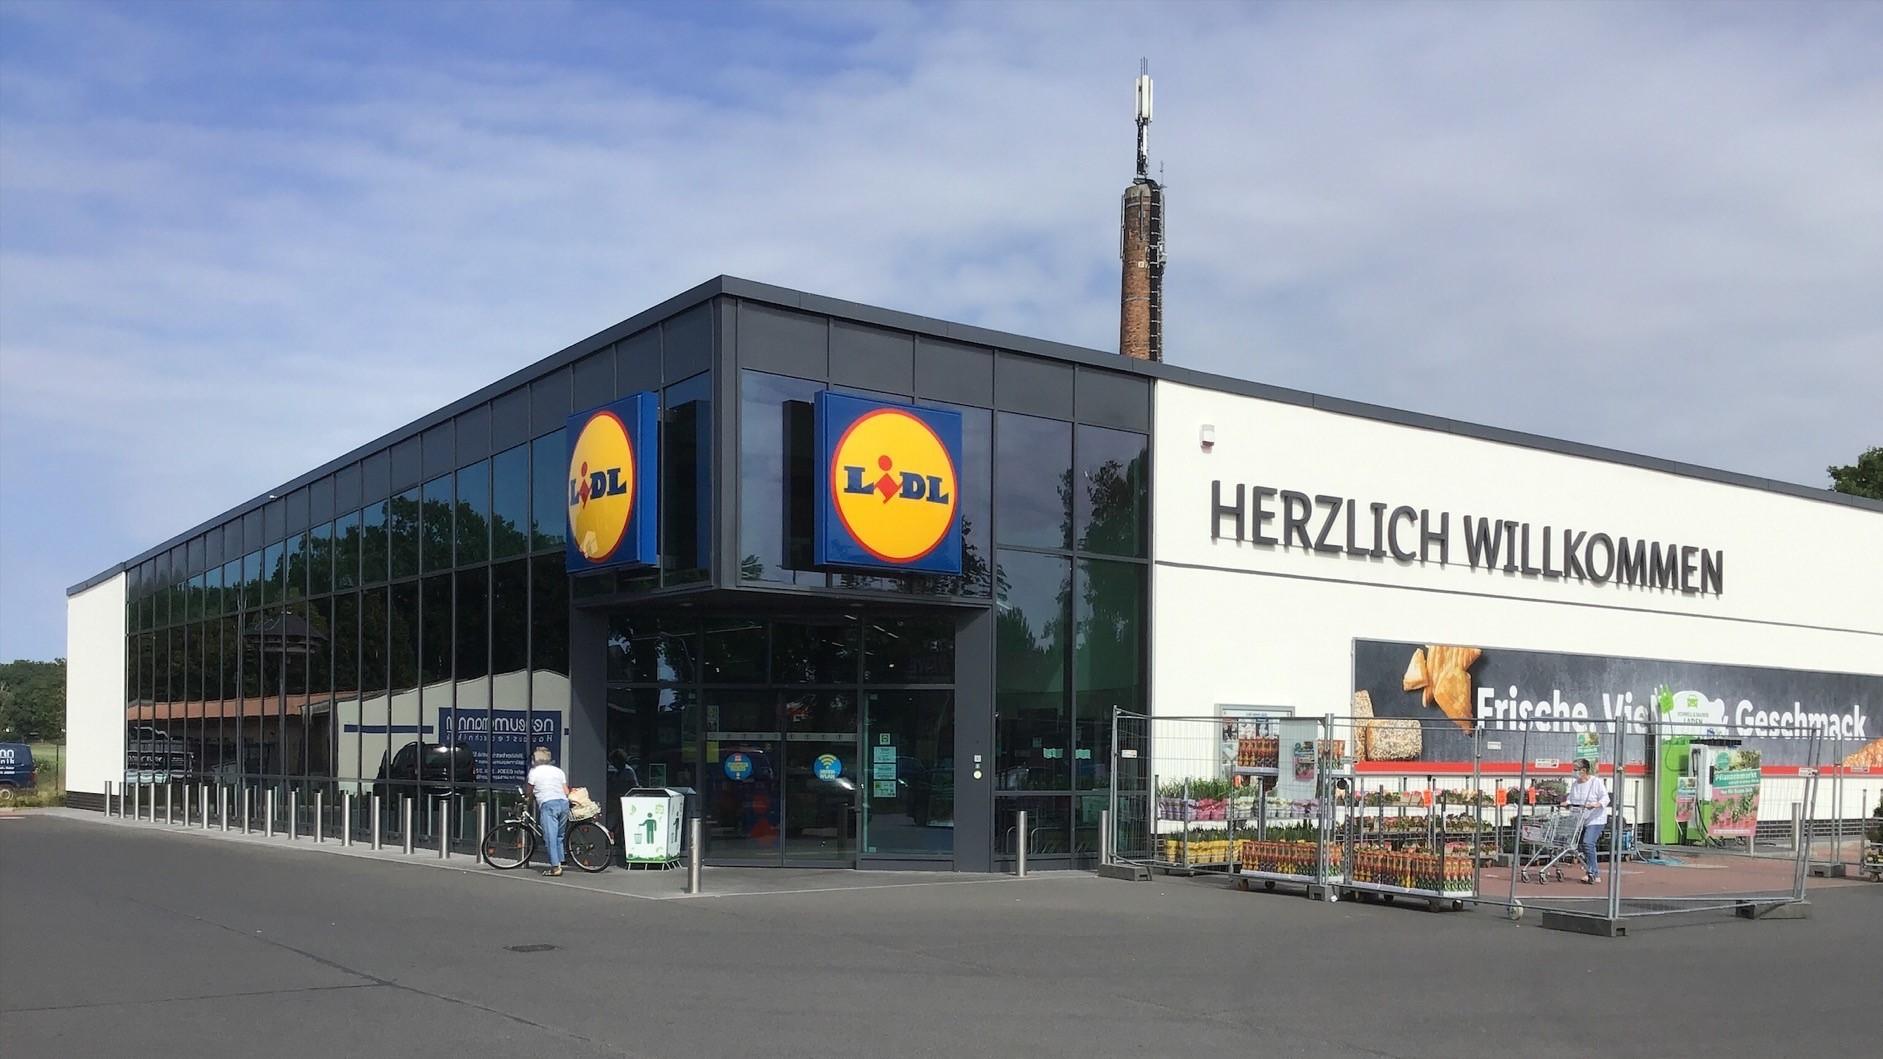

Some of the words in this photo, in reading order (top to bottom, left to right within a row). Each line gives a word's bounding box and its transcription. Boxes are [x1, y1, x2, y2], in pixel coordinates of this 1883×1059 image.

[1211, 480, 1449, 563] HERZLICH
[1463, 515, 1723, 594] WILLKOMMEN
[1735, 699, 1867, 741] Geschmack
